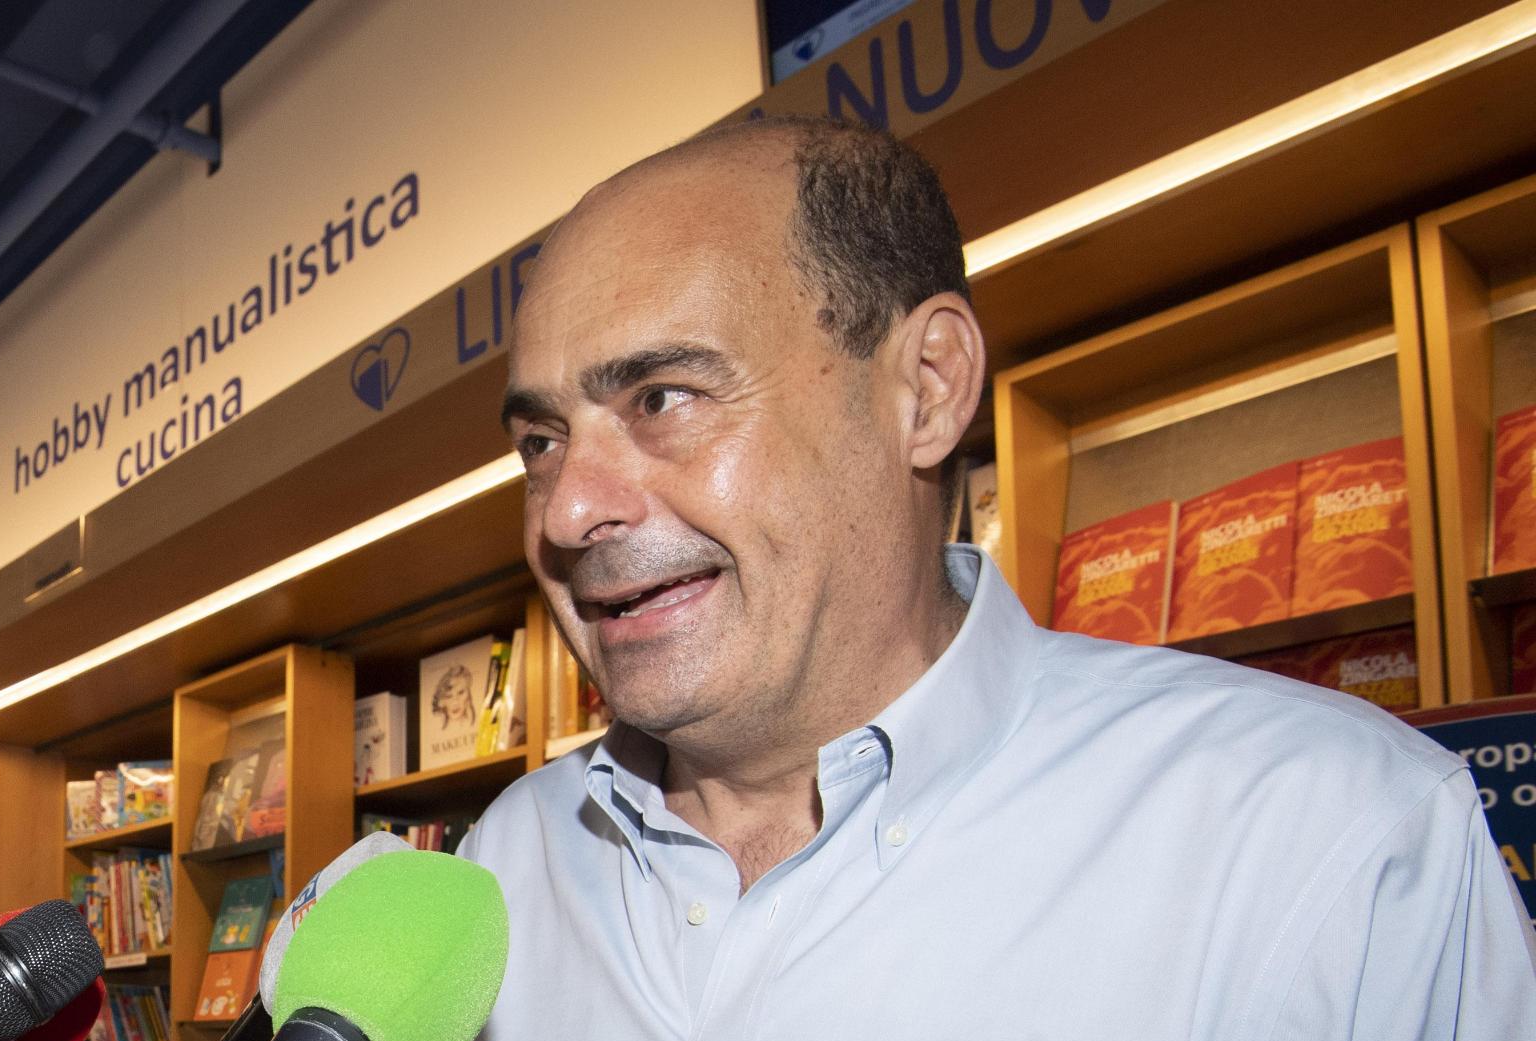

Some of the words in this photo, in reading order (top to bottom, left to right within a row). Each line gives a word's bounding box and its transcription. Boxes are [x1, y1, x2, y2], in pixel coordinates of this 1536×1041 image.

[825, 0, 1112, 132] NUO
[13, 394, 112, 494] hobby
[121, 172, 420, 418] manualistica
[116, 376, 243, 488] cucina
[1338, 652, 1410, 675] NICOLA
[1464, 741, 1536, 772] rop
